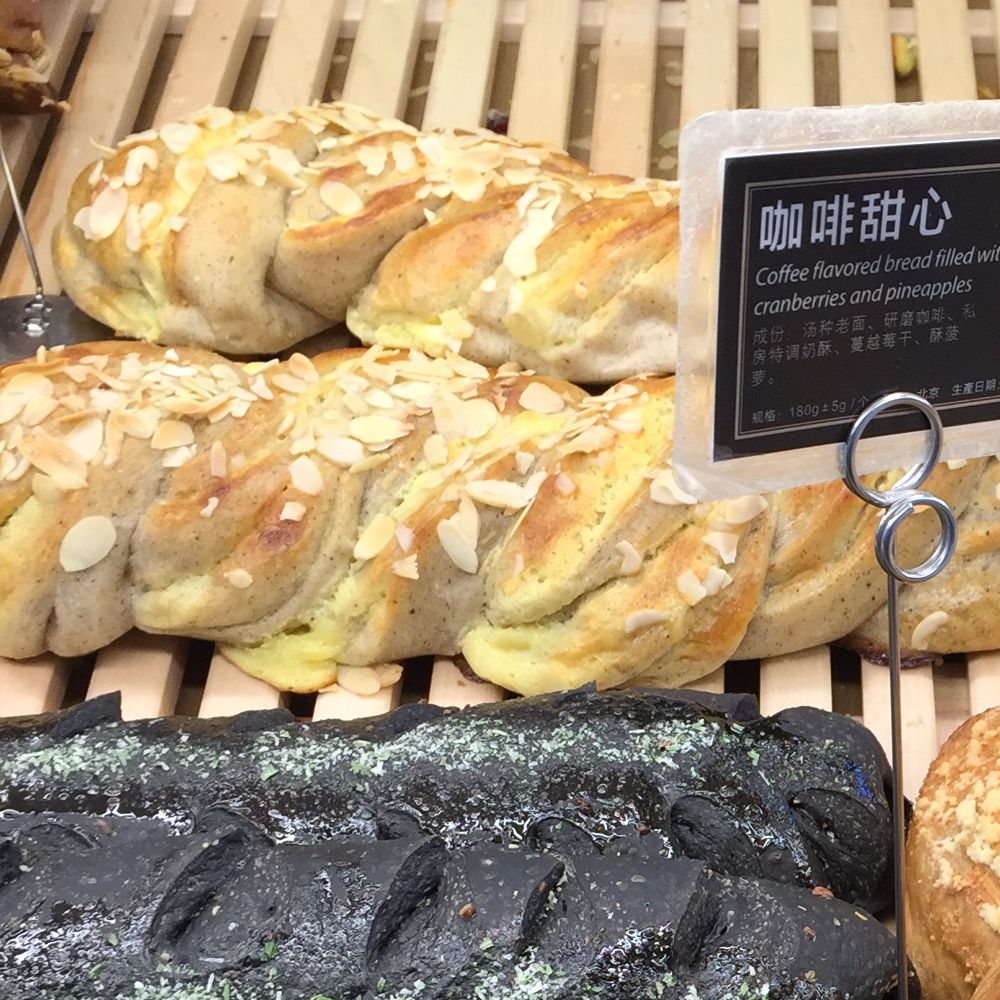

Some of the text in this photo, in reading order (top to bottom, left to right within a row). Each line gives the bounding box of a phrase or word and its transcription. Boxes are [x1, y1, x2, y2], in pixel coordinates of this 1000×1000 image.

[758, 187, 953, 252] 咖啡甜心
[755, 264, 810, 287] Coffee
[813, 254, 882, 281] flavored
[884, 249, 933, 273] bread
[935, 246, 976, 269] filled
[754, 276, 973, 316] cranberries and pineapples
